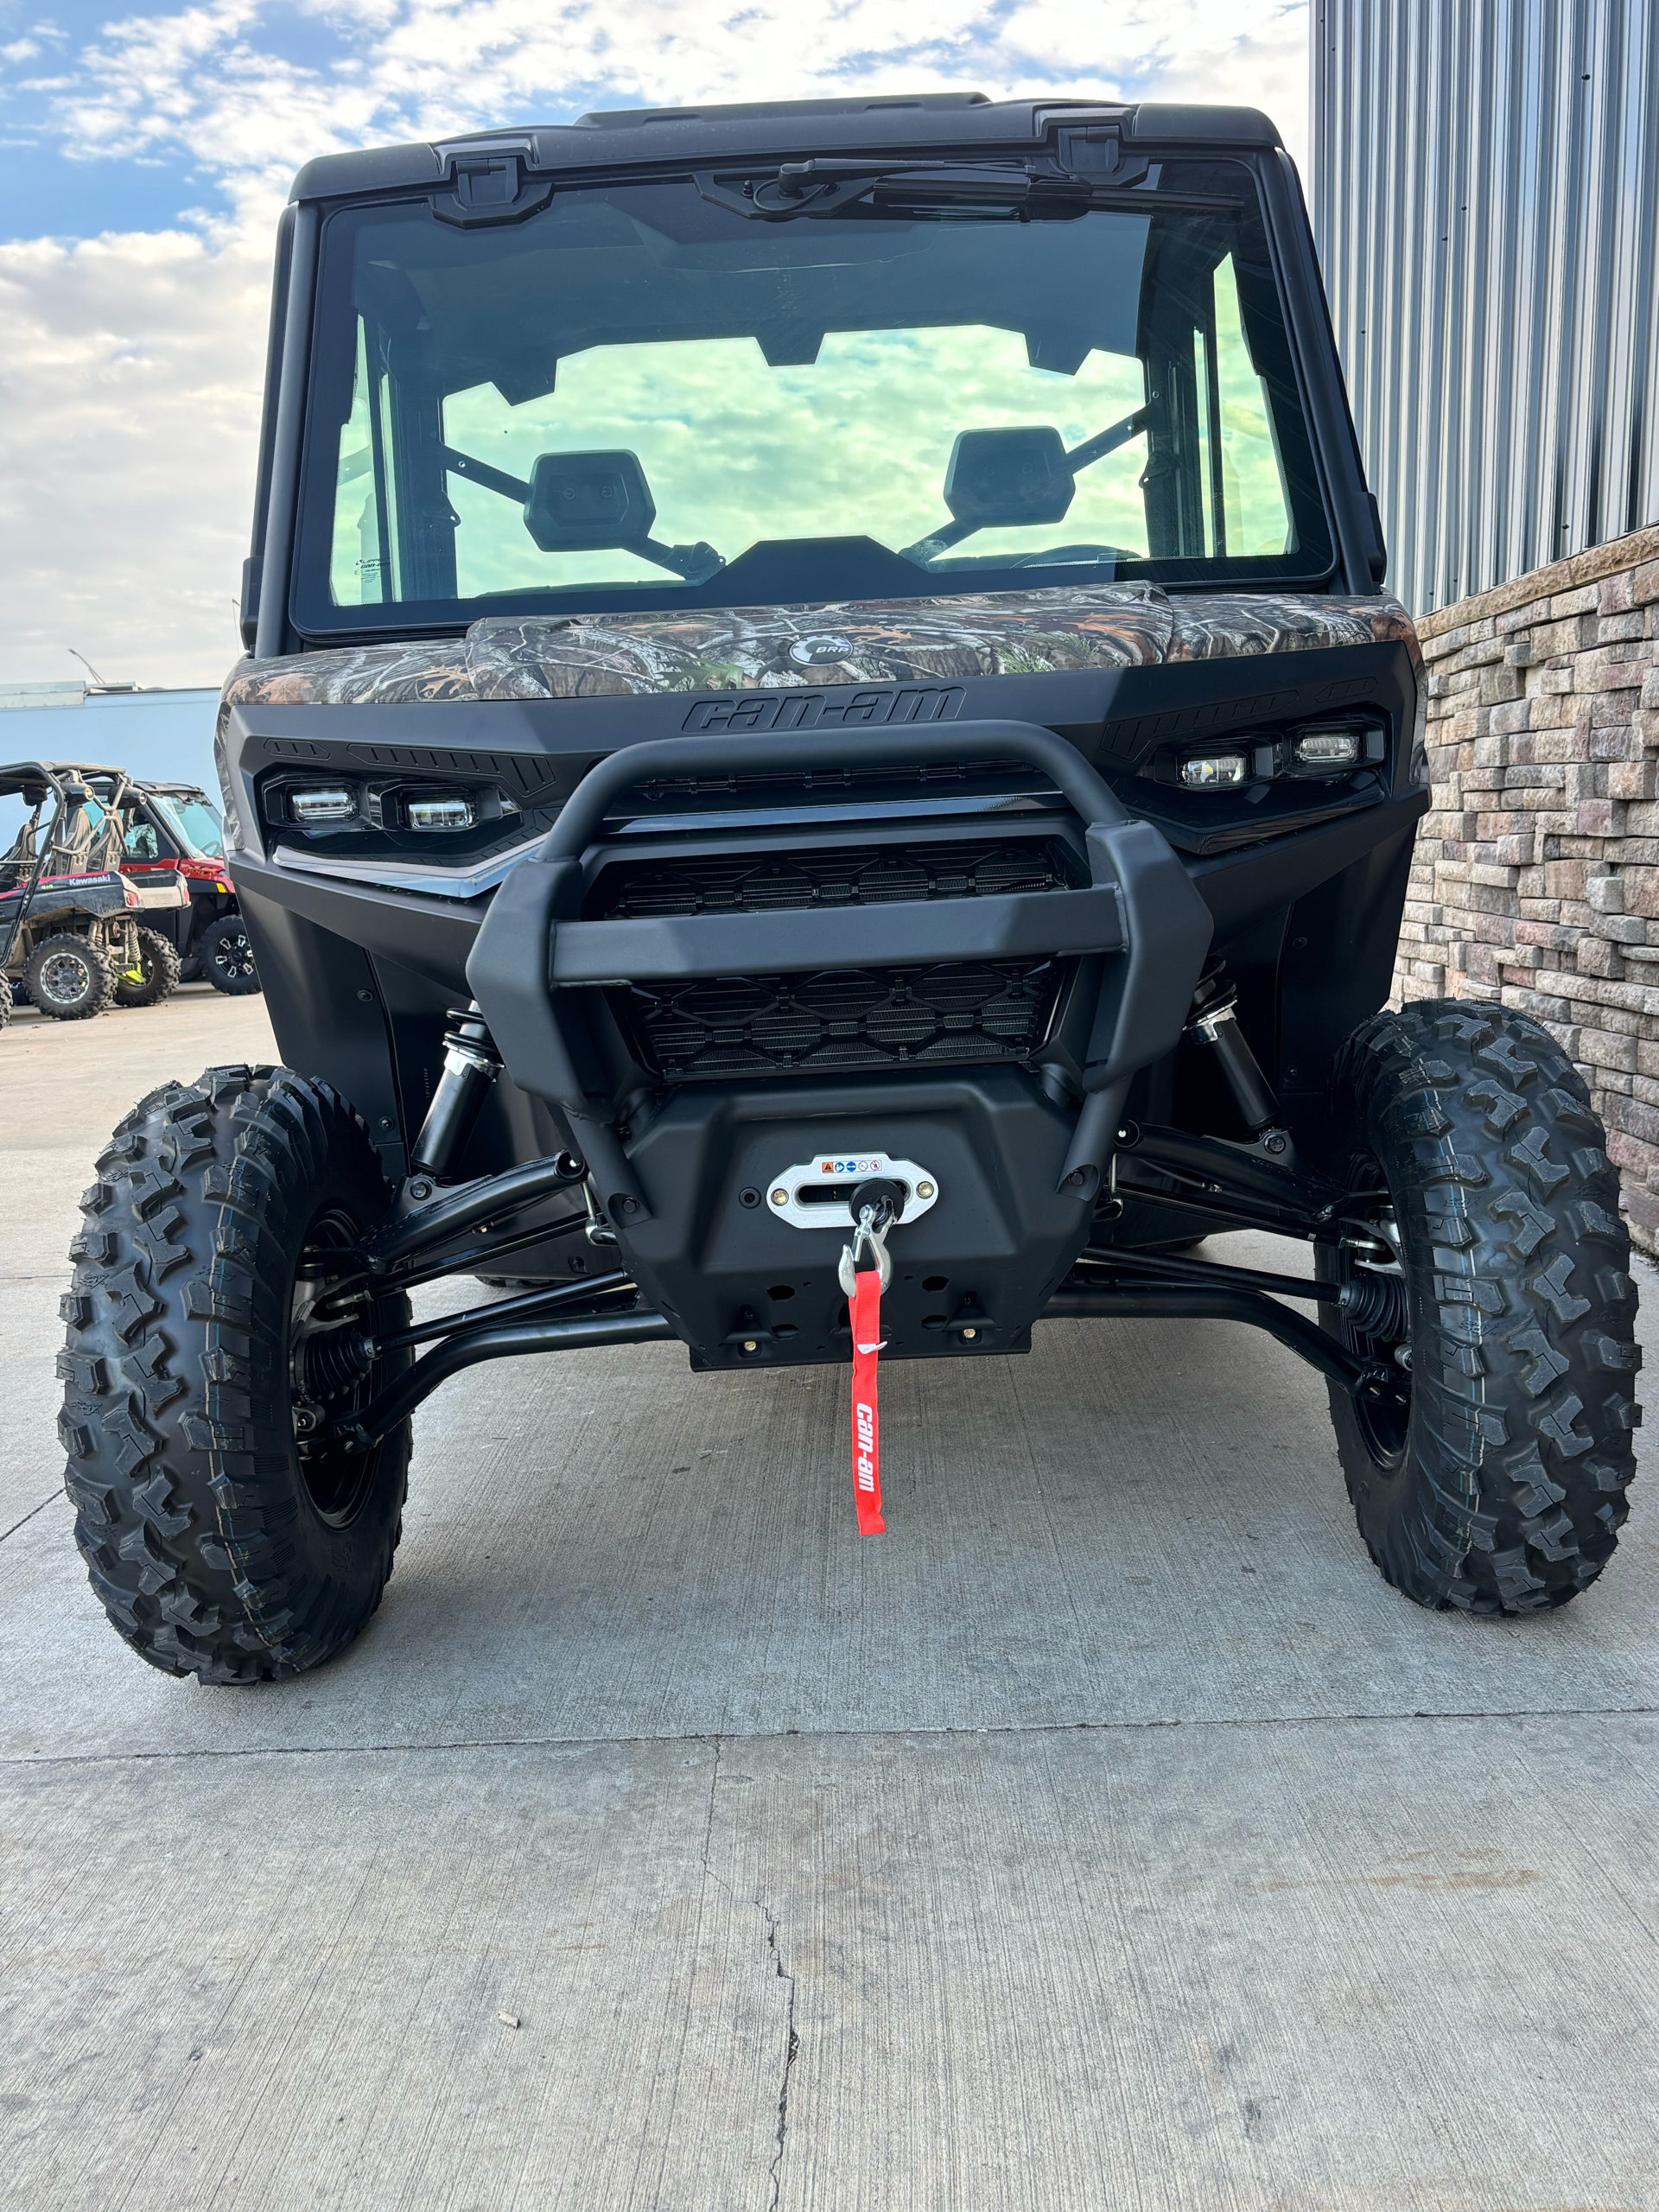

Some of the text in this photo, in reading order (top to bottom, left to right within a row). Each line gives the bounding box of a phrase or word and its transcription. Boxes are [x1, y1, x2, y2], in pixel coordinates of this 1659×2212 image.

[682, 686, 966, 734] can-am
[69, 874, 111, 886] Kawasaki
[856, 1402, 874, 1492] can-am
